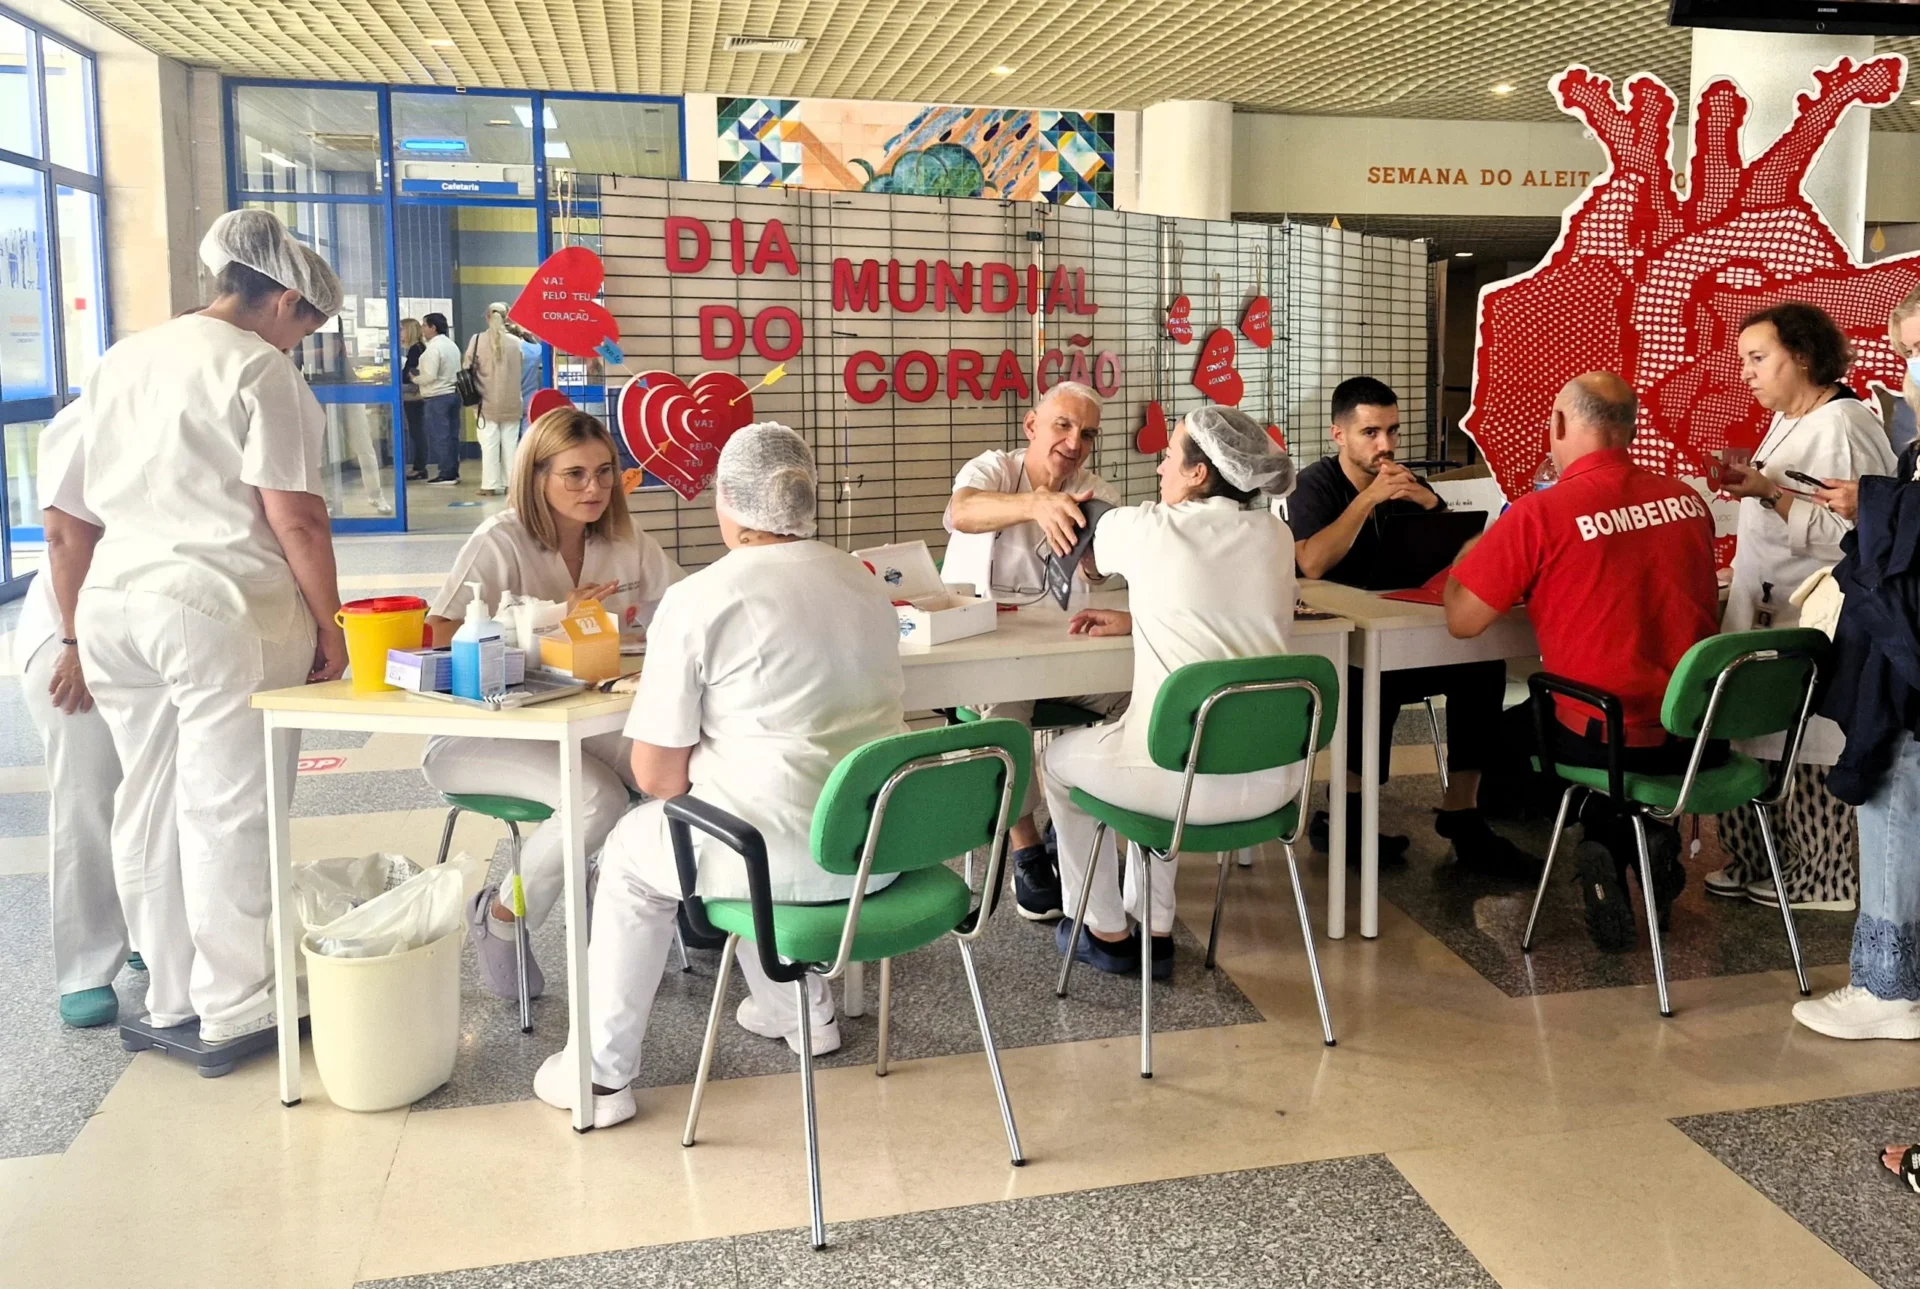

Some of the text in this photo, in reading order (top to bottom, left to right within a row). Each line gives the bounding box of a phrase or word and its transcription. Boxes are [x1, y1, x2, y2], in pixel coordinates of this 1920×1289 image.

[1367, 166, 1469, 185] SEMANA
[1480, 168, 1512, 186] DO
[441, 182, 480, 191] Cafetaria
[665, 216, 1099, 315] DIA MUNDIAL
[542, 277, 565, 286] VAI
[542, 291, 591, 301] PELO TEU
[699, 305, 1122, 404] DO CORAÇÃO
[694, 419, 714, 428] VAI
[689, 442, 713, 450] PELO
[684, 459, 704, 467] TEU
[1575, 495, 1706, 541] BOMBEIROS
